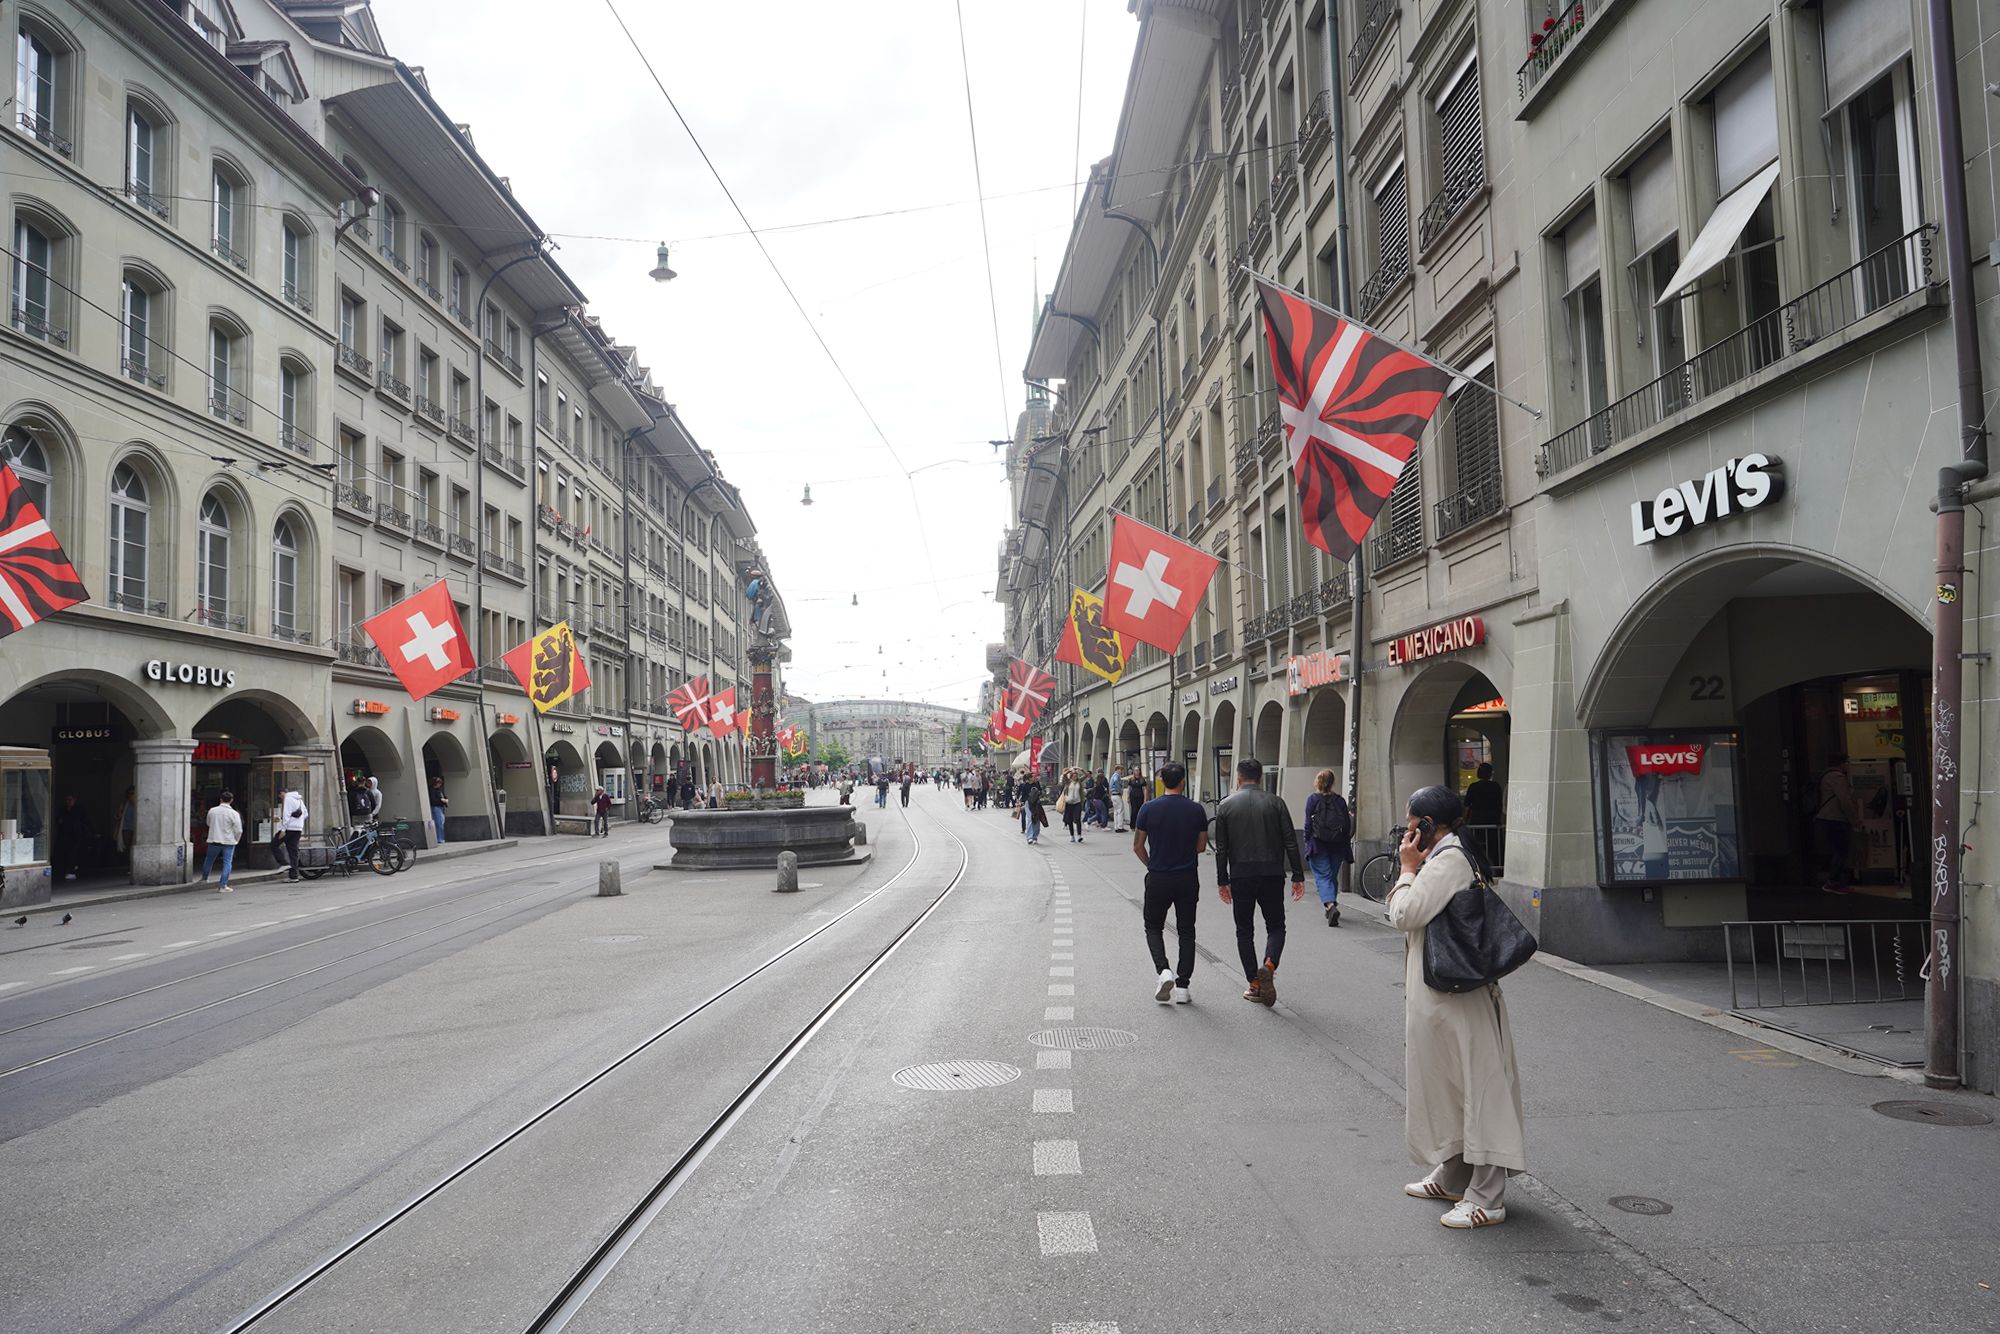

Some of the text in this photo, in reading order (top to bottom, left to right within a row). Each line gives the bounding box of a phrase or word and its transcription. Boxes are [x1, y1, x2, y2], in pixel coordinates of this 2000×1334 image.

[1388, 616, 1476, 666] EL MEXICANO
[145, 659, 236, 689] GLOBUS
[1300, 651, 1342, 689] Müller
[1689, 675, 1726, 701] 22
[58, 729, 112, 740] GLOBUS
[1690, 839, 1714, 853] MEDAL
